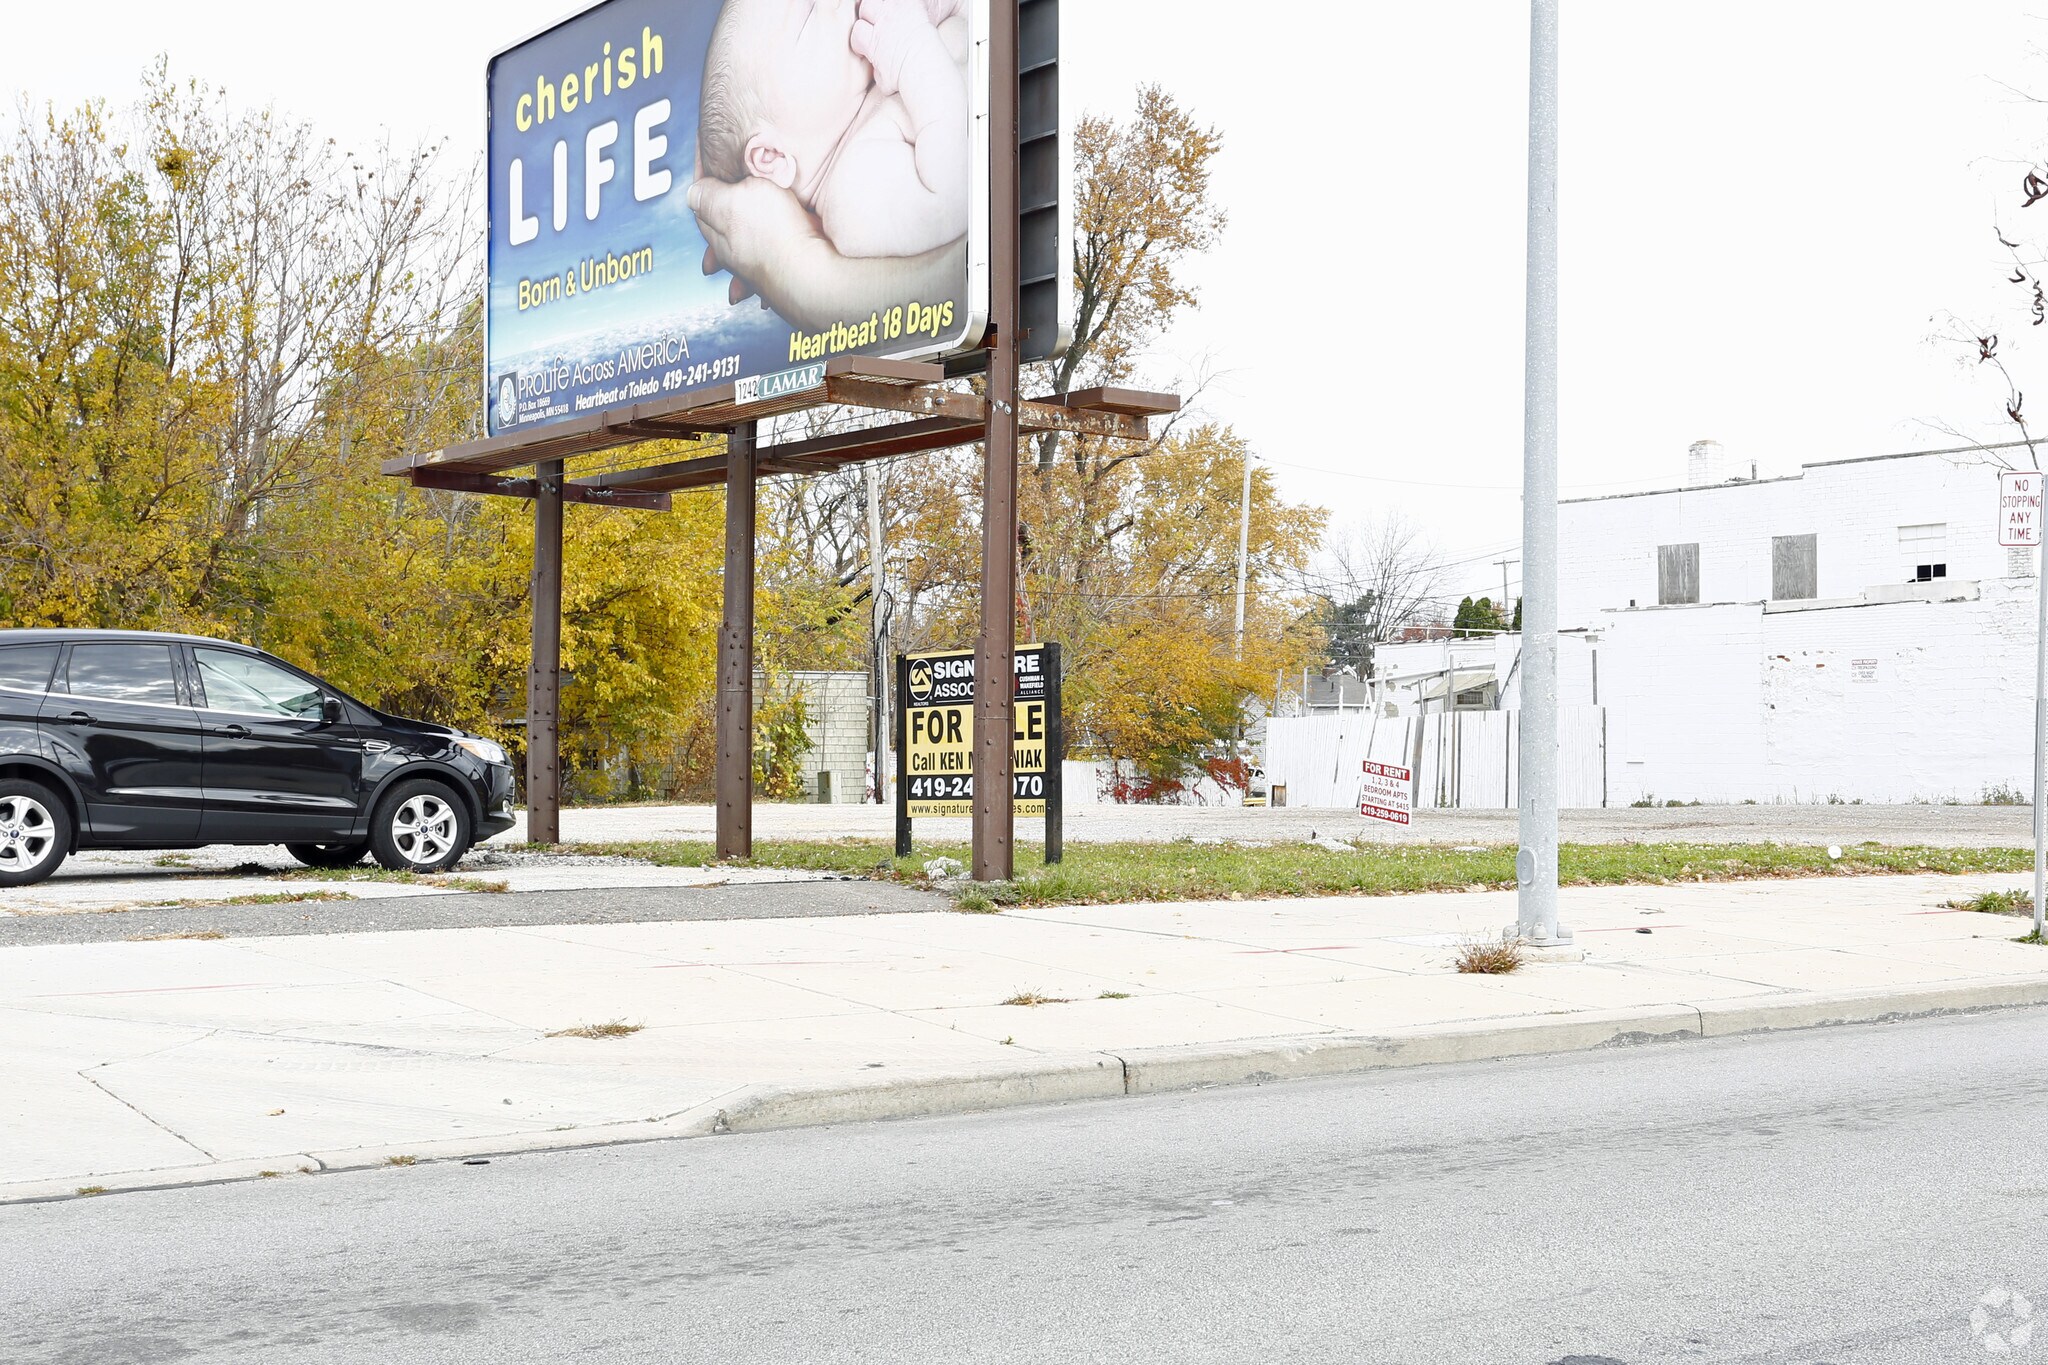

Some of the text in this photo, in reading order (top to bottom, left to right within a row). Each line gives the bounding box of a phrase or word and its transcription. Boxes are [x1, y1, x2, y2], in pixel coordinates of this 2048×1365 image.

[515, 26, 664, 132] cherish
[509, 98, 672, 247] LIFE
[518, 247, 653, 312] Born & Unborn
[789, 300, 954, 362] Heartbeat 18 Days
[575, 354, 740, 411] Heartbeat of Toledo 419-241-9131
[739, 380, 758, 400] 1242
[763, 367, 819, 396] LAMAR
[528, 400, 537, 410] Box
[546, 406, 555, 417] MN
[2014, 479, 2029, 492] NO
[2002, 495, 2041, 508] STOPPING
[2009, 511, 2032, 524] ANY
[2008, 527, 2032, 540] TIME
[933, 654, 1040, 680] SIGNRE
[934, 682, 974, 698] ASSOC
[912, 704, 1043, 745] FOR LE
[912, 752, 936, 772] Call
[940, 751, 964, 771] KEN
[1365, 762, 1407, 779] FOR RENT
[1361, 794, 1388, 806] STARTING
[1364, 784, 1408, 801] BEDROOM APTS
[911, 804, 1045, 816] www.signaturees.com
[1362, 805, 1408, 823] 419-259-0619
